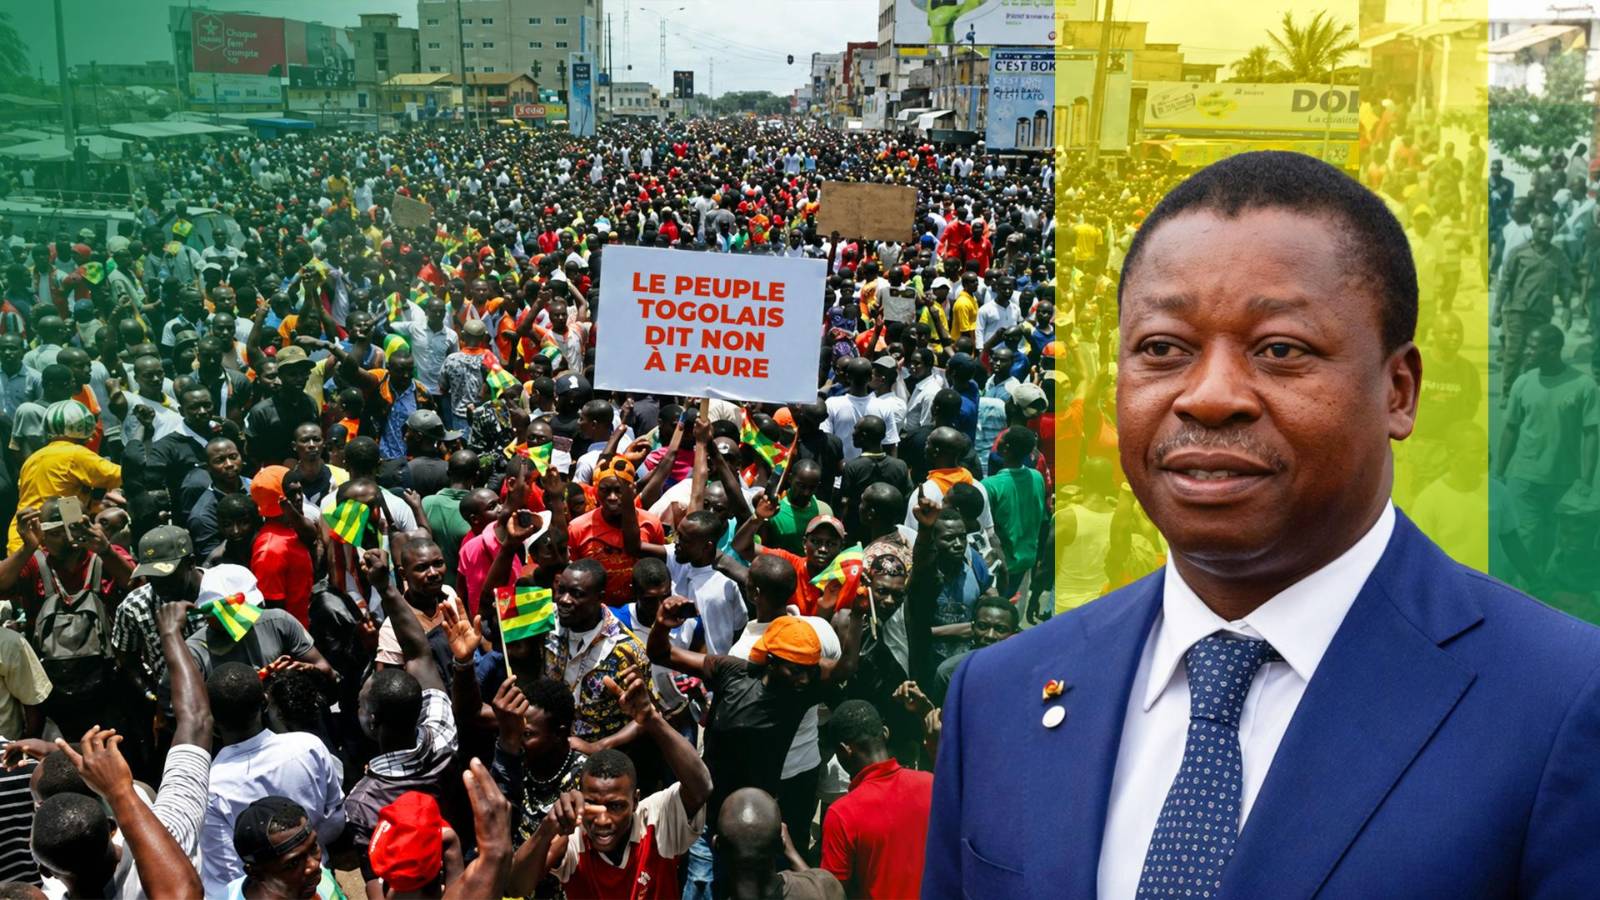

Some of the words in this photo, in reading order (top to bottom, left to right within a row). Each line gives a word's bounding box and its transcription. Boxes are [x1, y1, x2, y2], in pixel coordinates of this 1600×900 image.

[995, 61, 1027, 72] C'EST
[632, 272, 666, 294] LE
[675, 275, 785, 302] PEUPLE
[638, 299, 785, 328] TOGOLAIS
[645, 325, 693, 347] DIT
[701, 329, 765, 352] NON
[644, 346, 666, 372] À
[674, 353, 769, 378] FAURE
